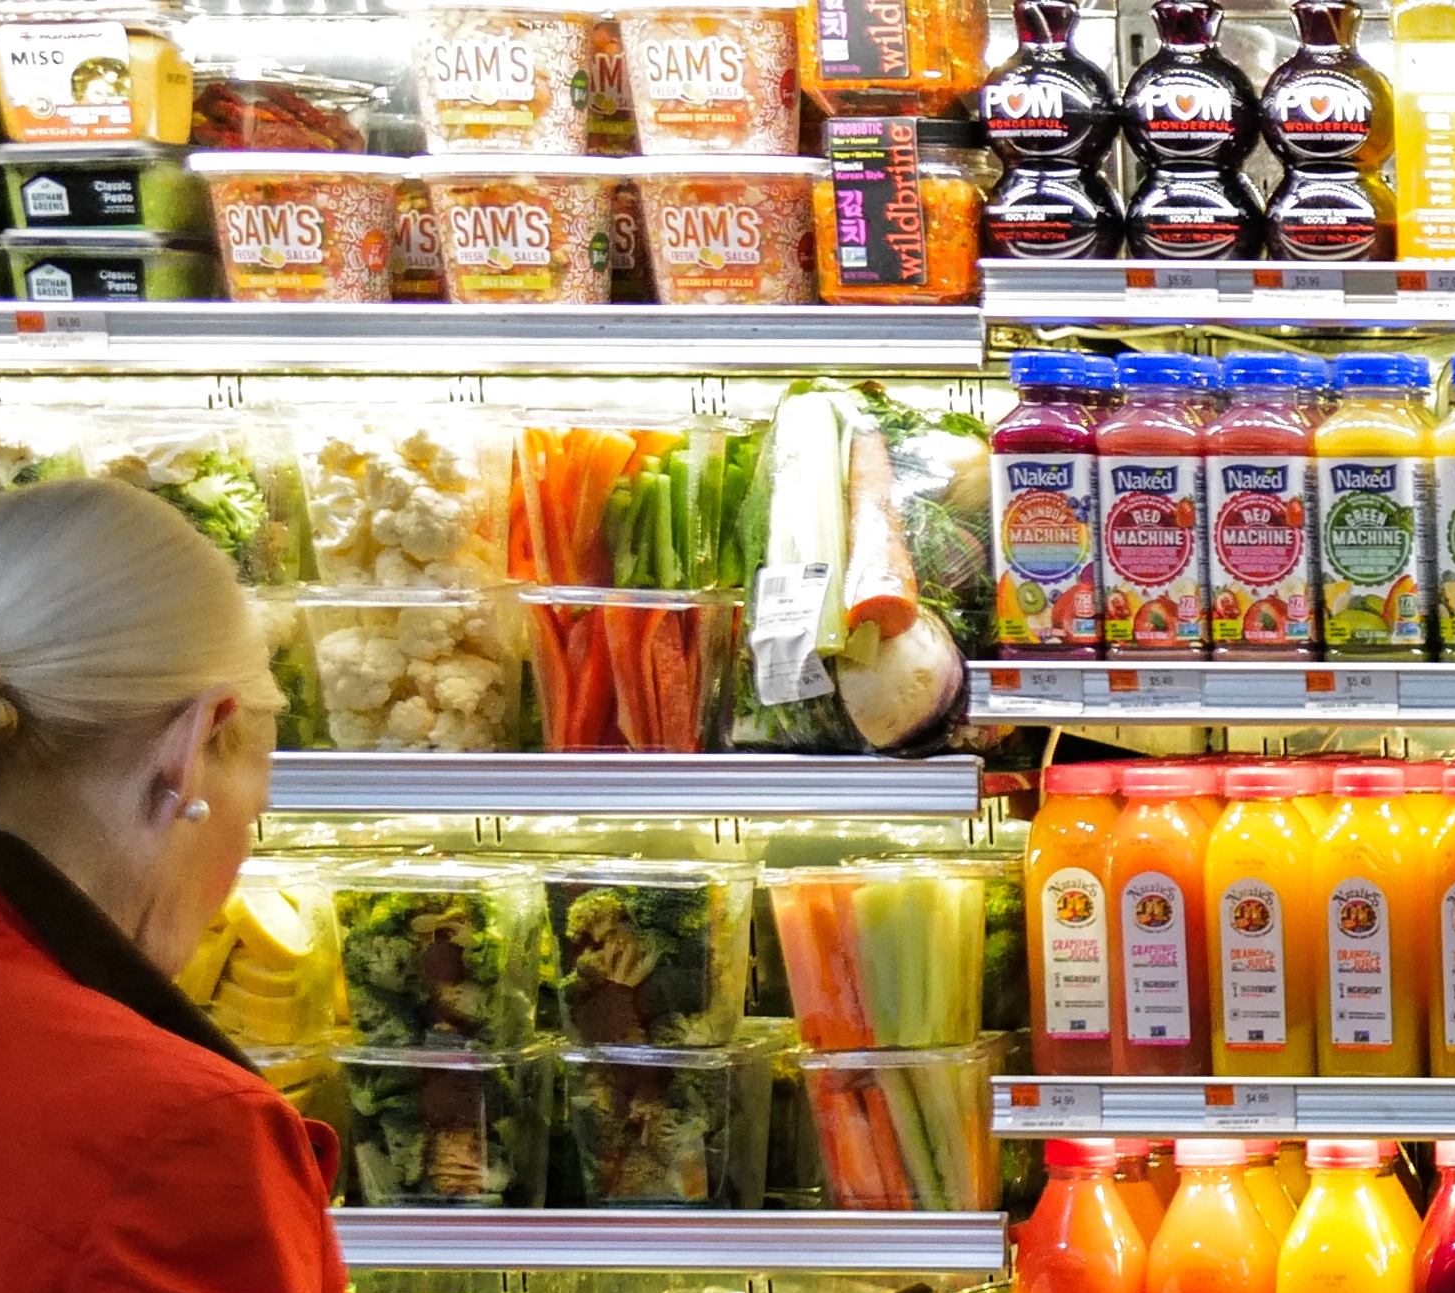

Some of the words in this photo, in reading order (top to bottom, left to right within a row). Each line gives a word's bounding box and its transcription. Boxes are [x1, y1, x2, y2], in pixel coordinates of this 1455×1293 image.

[10, 50, 64, 66] MISO
[434, 39, 529, 82] SAM'S
[646, 39, 741, 82] SAM'S
[985, 84, 1064, 119] POM
[1144, 86, 1233, 121] POM
[1281, 86, 1367, 122] POM
[833, 123, 883, 135] PROBIOTIC
[1284, 122, 1369, 132] WONDERFUL
[885, 123, 921, 280] wildbrine
[228, 202, 320, 246] SAM'S
[452, 205, 548, 248] SAM'S
[665, 206, 757, 248] SAM'S
[1013, 466, 1069, 488] Naked
[1131, 509, 1161, 525] RED
[1345, 509, 1388, 527] GREEN
[1113, 528, 1184, 546] MACHINE
[1333, 528, 1404, 546] MACHINE
